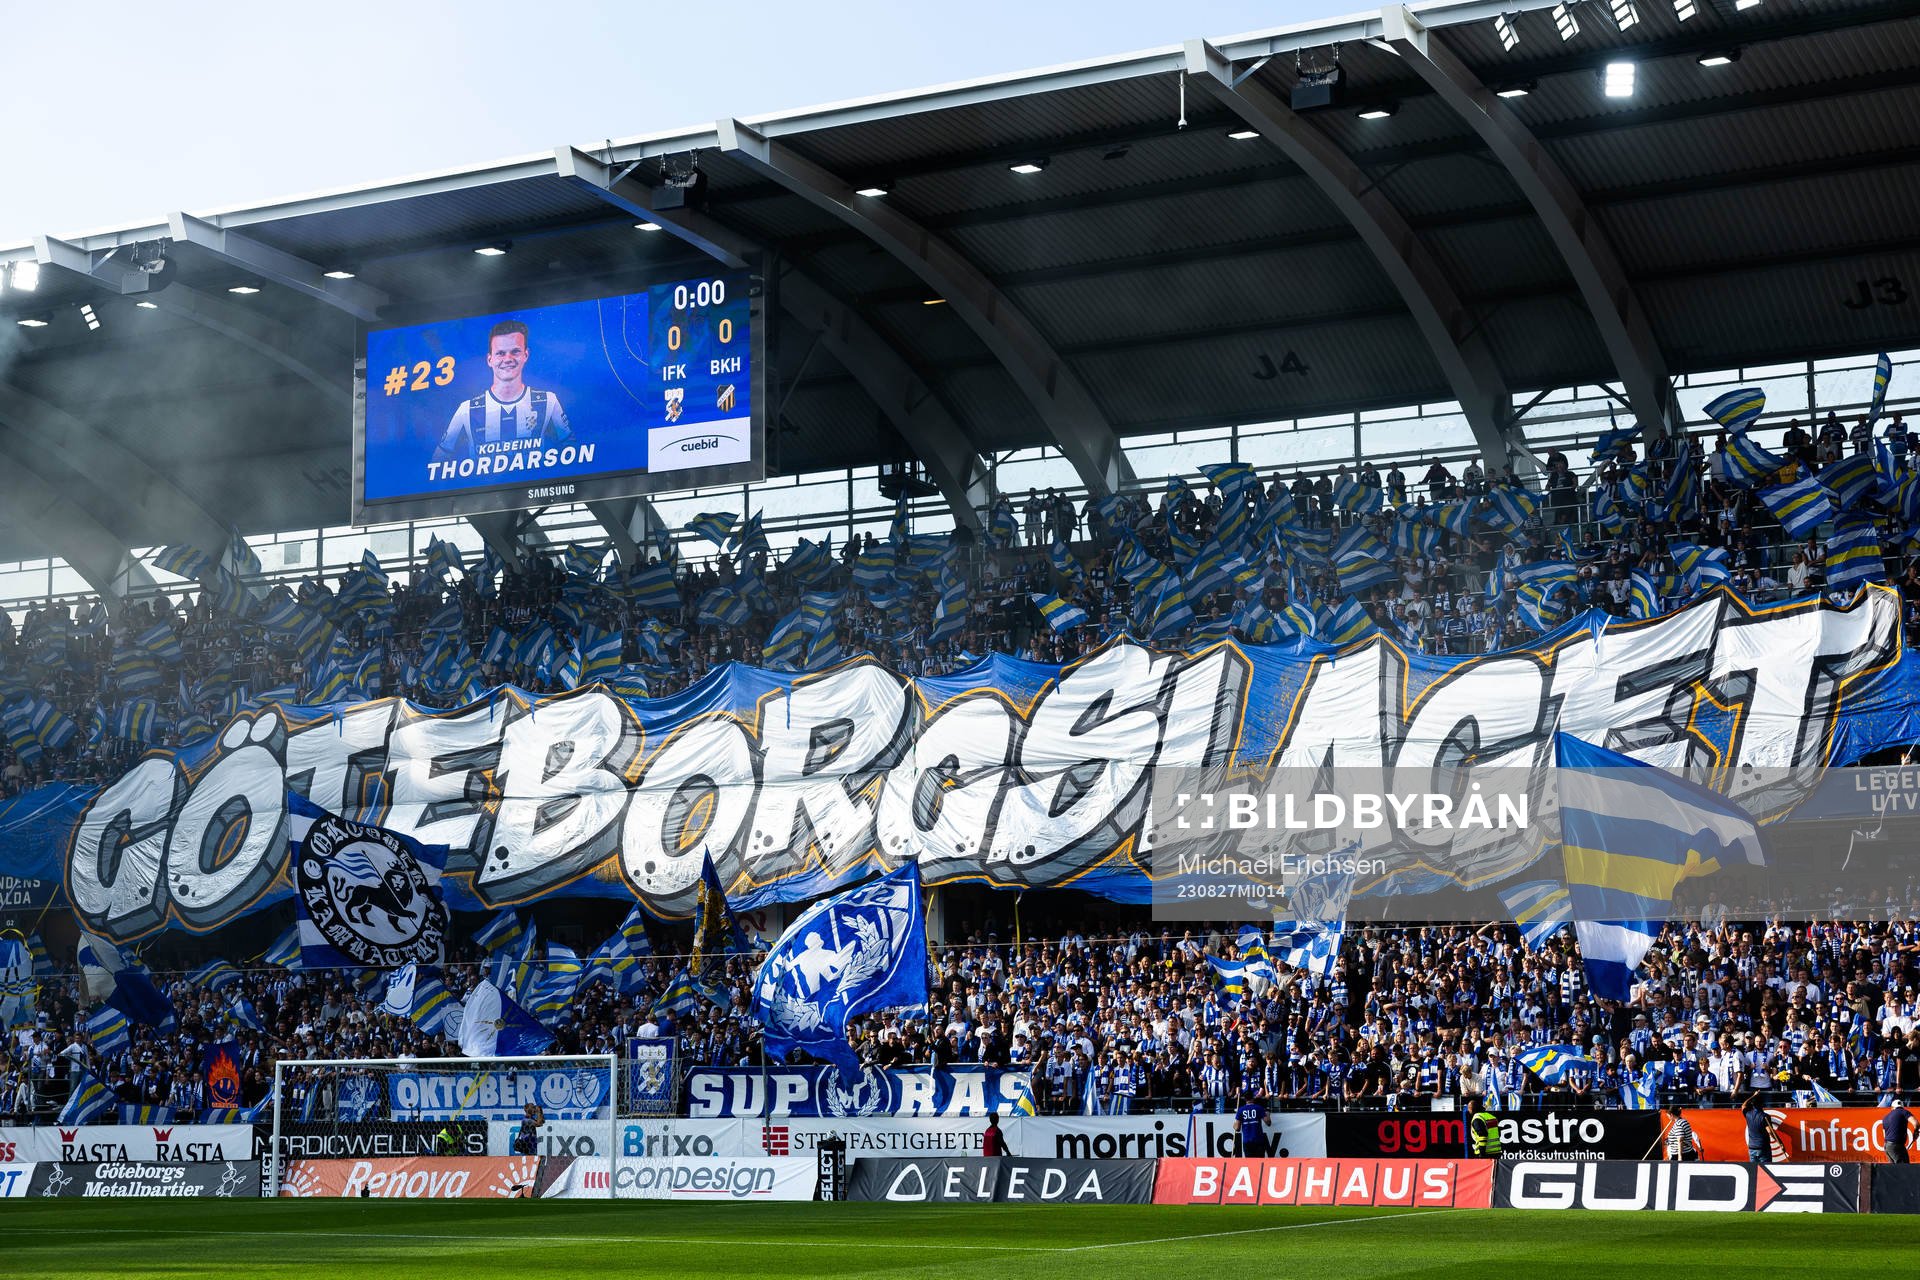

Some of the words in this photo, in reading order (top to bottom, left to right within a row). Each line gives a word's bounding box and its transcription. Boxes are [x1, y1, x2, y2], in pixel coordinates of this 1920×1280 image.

[673, 280, 725, 310] 0:00
[1844, 277, 1908, 310] J3
[667, 326, 681, 351] 0
[719, 319, 732, 344] 0
[384, 356, 455, 396] #23
[662, 364, 687, 382] IFK
[710, 357, 741, 376] BKH
[1252, 350, 1311, 380] J4
[478, 438, 542, 455] KOLBEINN
[681, 437, 719, 452] cuebid
[427, 444, 595, 481] THORDARSON
[528, 484, 575, 500] SAMSUNG
[1855, 771, 1920, 791] LEGE
[1871, 792, 1920, 811] UTV
[397, 1074, 537, 1109] OKTOBER
[690, 1074, 809, 1118] SUP
[1242, 1109, 1257, 1120] SLO
[623, 1125, 718, 1157] Brixo.
[794, 1132, 985, 1149] STFASTIGHETE
[1056, 1120, 1186, 1158] morris
[1378, 1118, 1464, 1153] ggm
[1498, 1111, 1605, 1144] astro
[1800, 1118, 1920, 1152] InfraC
[61, 1143, 129, 1161] RASTA
[155, 1143, 225, 1161] RASTA
[1500, 1150, 1605, 1160] torköksutrustning
[95, 1162, 185, 1181] Göteborgs
[342, 1161, 471, 1198] Renova
[821, 1149, 834, 1201] SELECT
[943, 1167, 1104, 1200] ELEDA
[1192, 1165, 1450, 1200] BAUHAUS
[82, 1182, 203, 1197] Metallpartier
